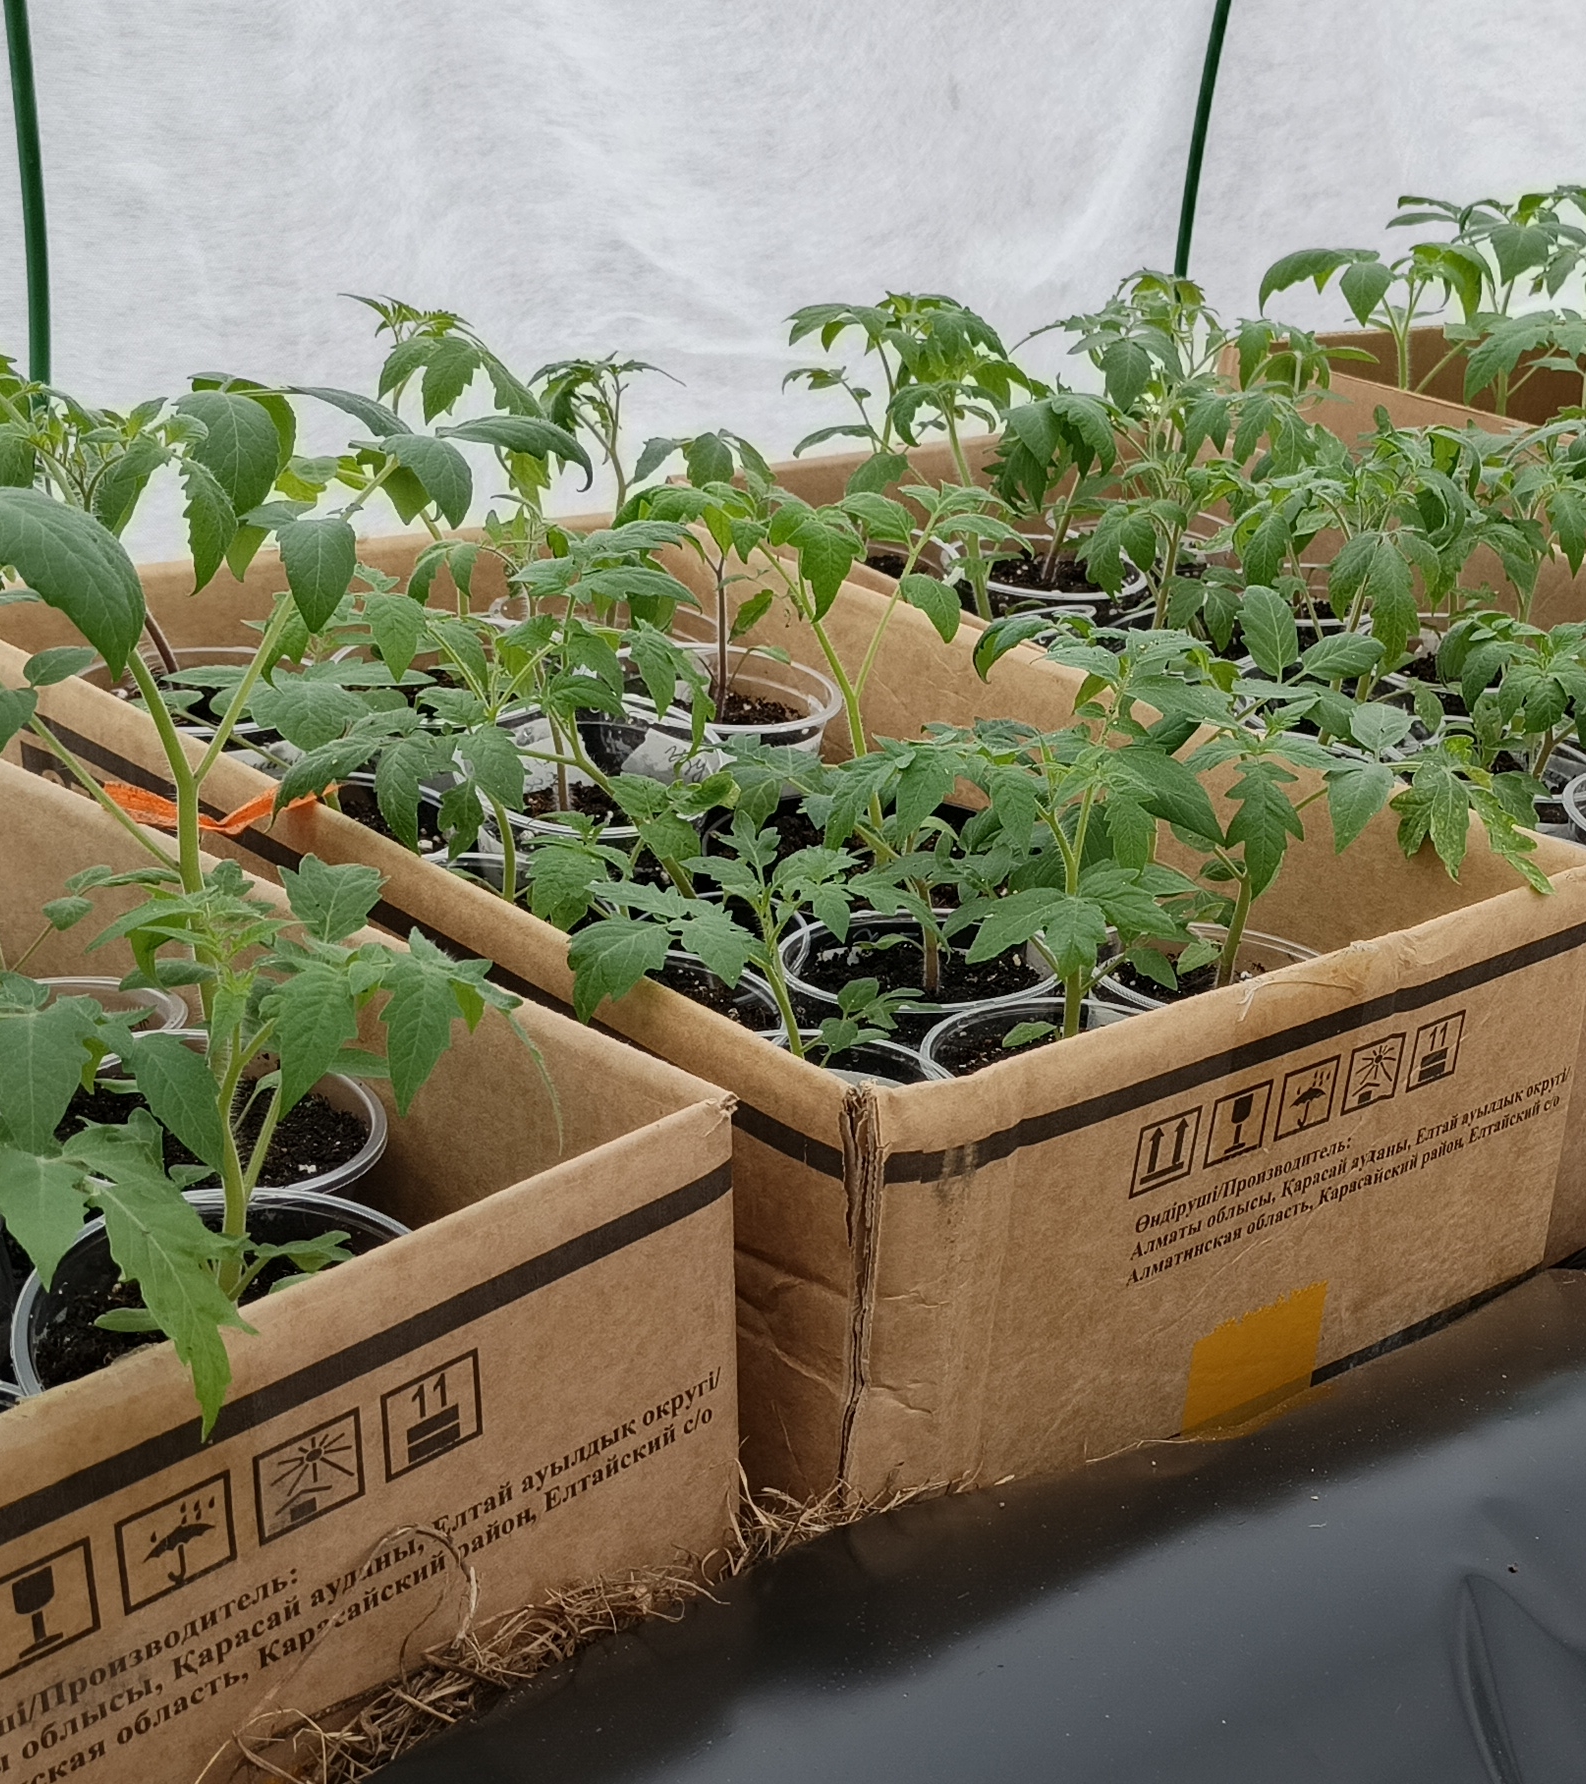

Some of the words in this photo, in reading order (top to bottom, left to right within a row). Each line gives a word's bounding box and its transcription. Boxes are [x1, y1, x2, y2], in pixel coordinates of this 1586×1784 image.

[1428, 1021, 1450, 1051] 11
[1126, 1227, 1243, 1287] Алматинская
[1246, 1200, 1313, 1235] область,
[1318, 1152, 1418, 1205] Карасайский
[1420, 1137, 1464, 1169] район,
[1468, 1099, 1541, 1144] Елтайский
[1130, 1219, 1201, 1261] Алматы
[1207, 1190, 1276, 1228] облысы,
[1350, 1138, 1411, 1171] ауданы,
[1415, 1113, 1458, 1146] Елтай
[411, 1372, 448, 1419] 11
[117, 1670, 249, 1745] область,
[543, 1423, 677, 1512] Елтайский
[683, 1408, 713, 1435] с/о
[22, 1678, 164, 1760] облысы,
